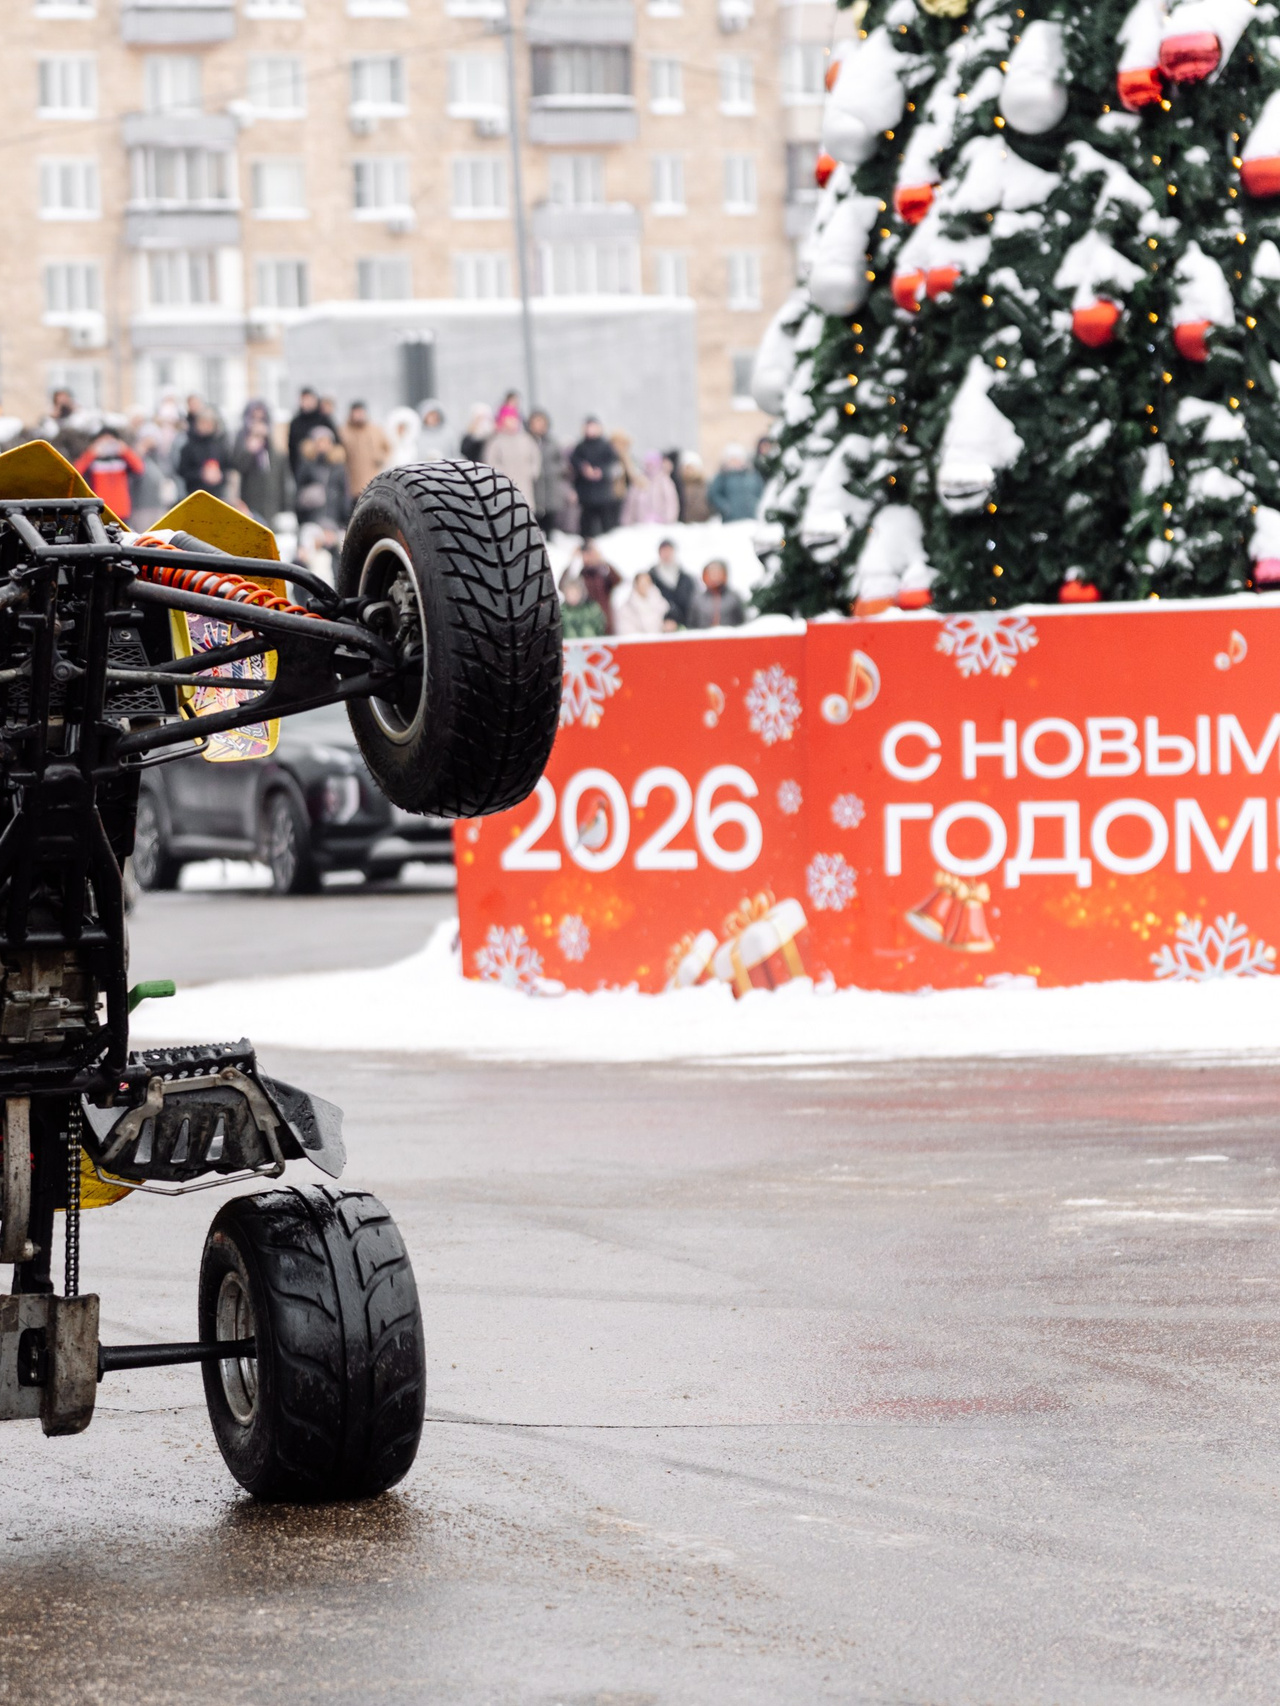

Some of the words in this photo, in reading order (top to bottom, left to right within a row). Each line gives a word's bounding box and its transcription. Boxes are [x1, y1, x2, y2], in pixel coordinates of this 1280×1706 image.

[880, 720, 942, 782] С
[960, 713, 1280, 780] НОВЫМ
[500, 764, 763, 873] 2026
[883, 796, 1280, 889] ГОДОМ
